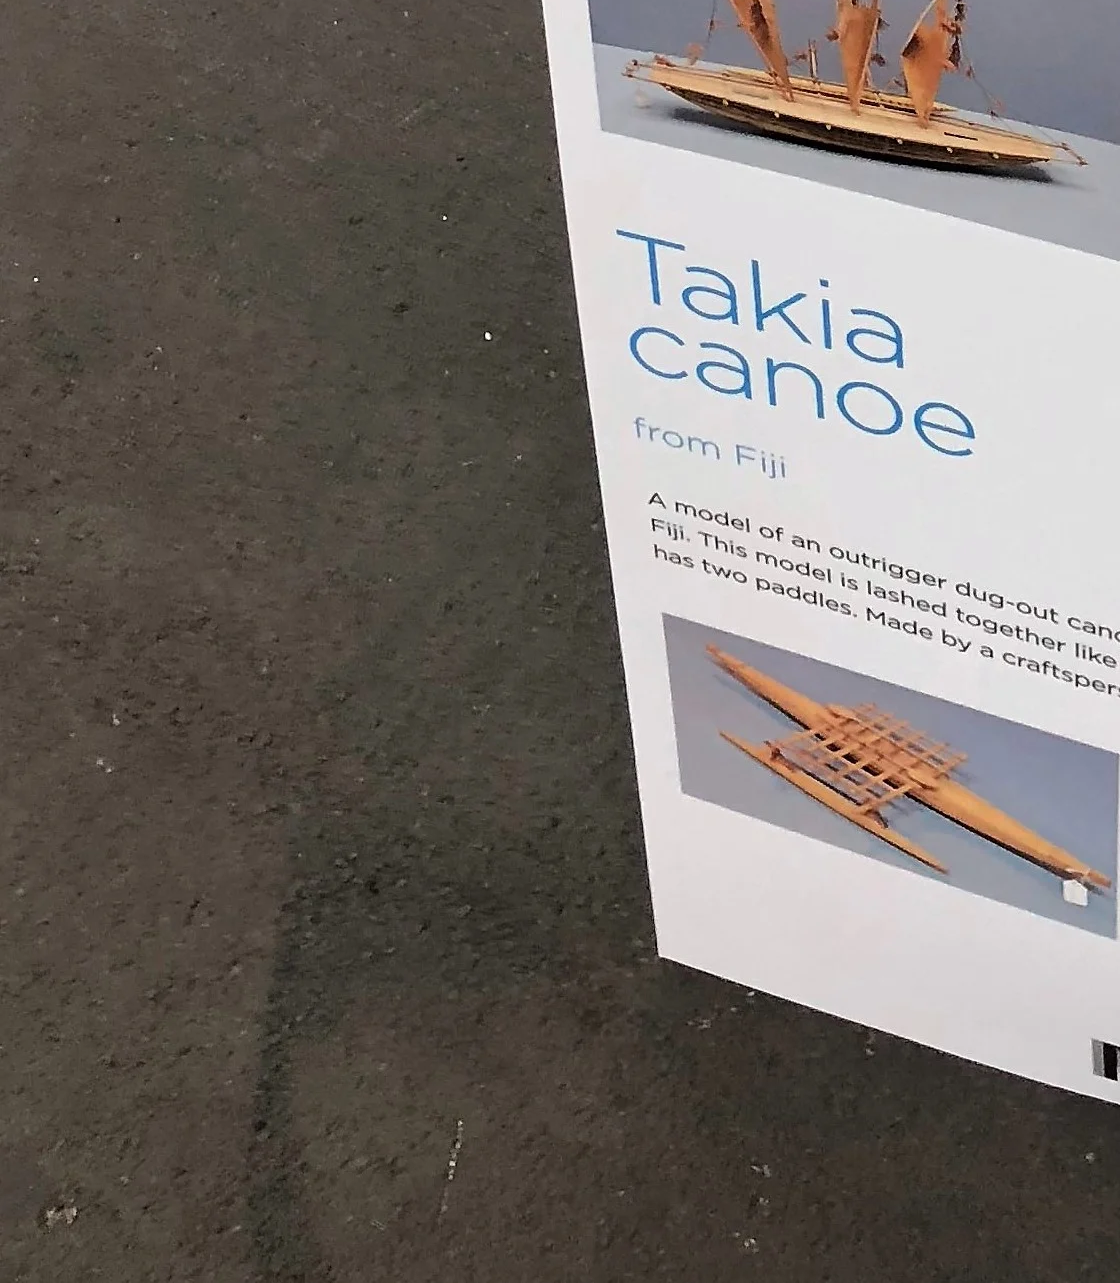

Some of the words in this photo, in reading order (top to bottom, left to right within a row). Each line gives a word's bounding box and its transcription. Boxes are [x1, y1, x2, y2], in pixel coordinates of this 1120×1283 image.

[615, 229, 905, 369] Takia
[629, 325, 977, 458] canoe
[633, 416, 721, 461] from
[735, 443, 788, 480] Fiji
[648, 492, 668, 510] A
[673, 498, 751, 534] model
[758, 524, 785, 543] of
[790, 534, 822, 554] an
[828, 544, 948, 591] outrigger
[955, 579, 1059, 625] dug-out
[650, 517, 691, 543] Fiji.
[697, 530, 748, 559] This
[755, 550, 832, 584] model
[840, 572, 859, 592] is
[866, 580, 948, 618] lashed
[955, 606, 1067, 654] together
[1074, 642, 1118, 670] like
[653, 543, 695, 570] has
[701, 558, 748, 584] two
[755, 576, 858, 619] paddles.
[865, 606, 934, 641] Made
[941, 628, 971, 654] by
[979, 644, 995, 659] a
